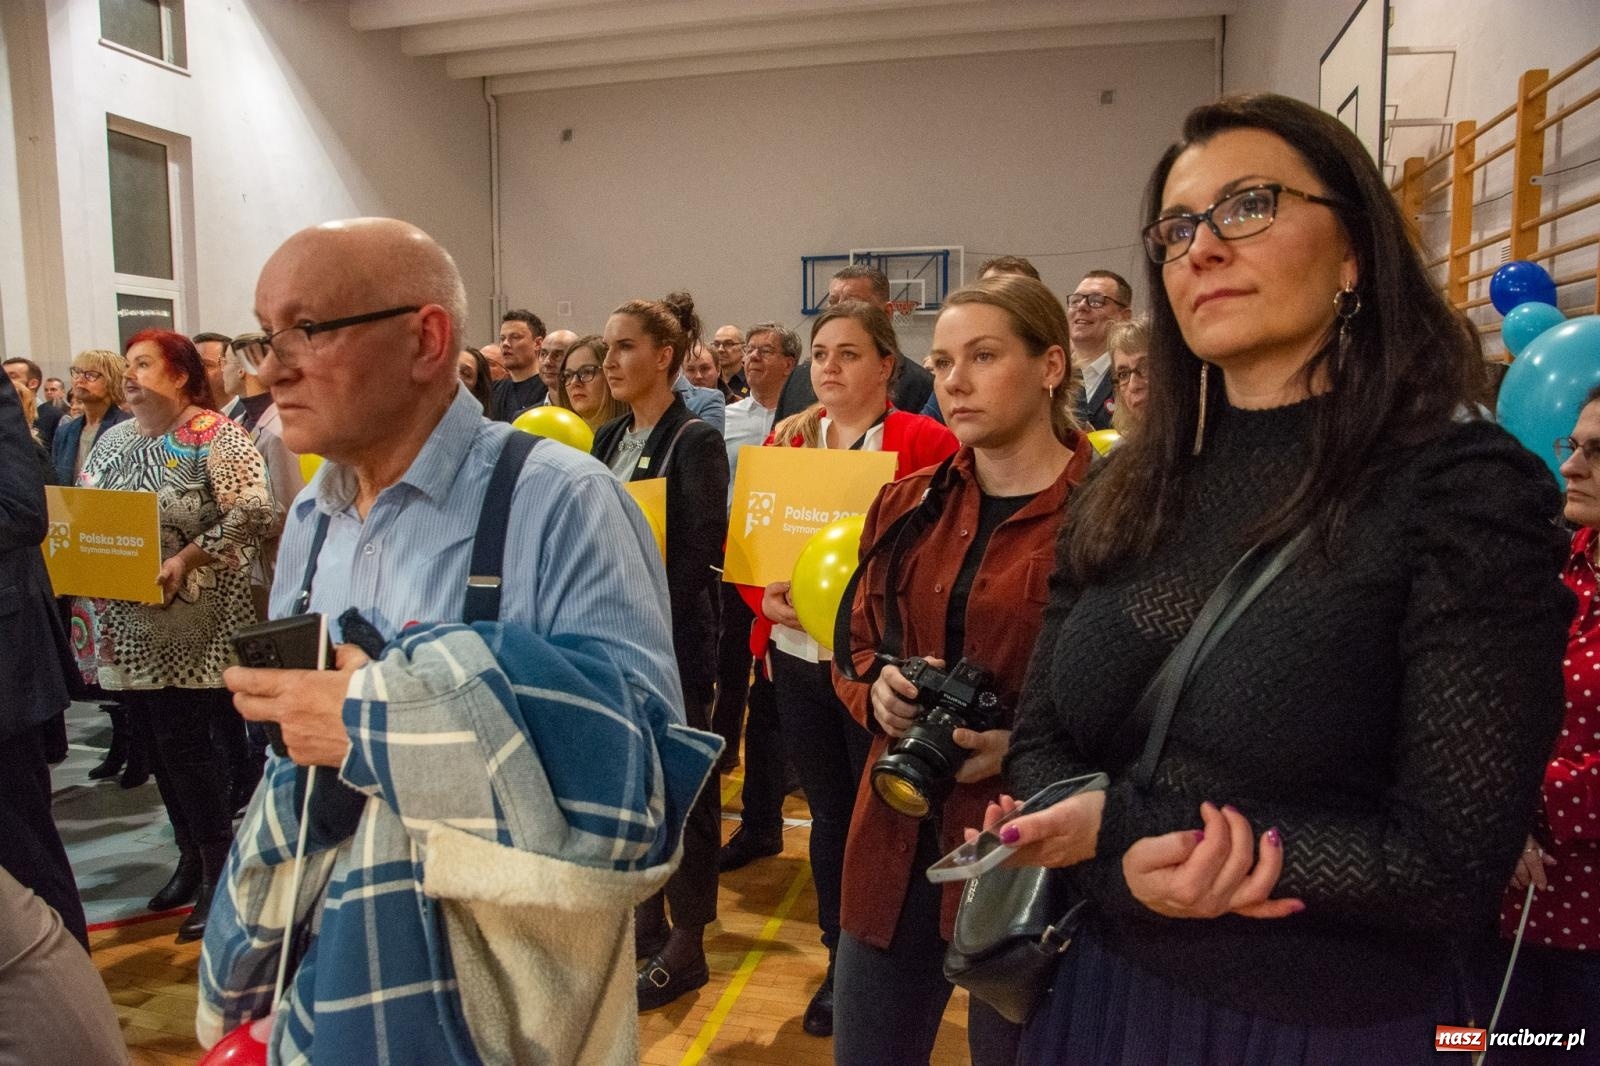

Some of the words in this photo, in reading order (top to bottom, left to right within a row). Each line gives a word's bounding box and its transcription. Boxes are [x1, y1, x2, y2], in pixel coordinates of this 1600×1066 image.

[784, 505, 830, 523] Polska
[79, 532, 115, 545] Polska
[116, 535, 145, 547] 2050
